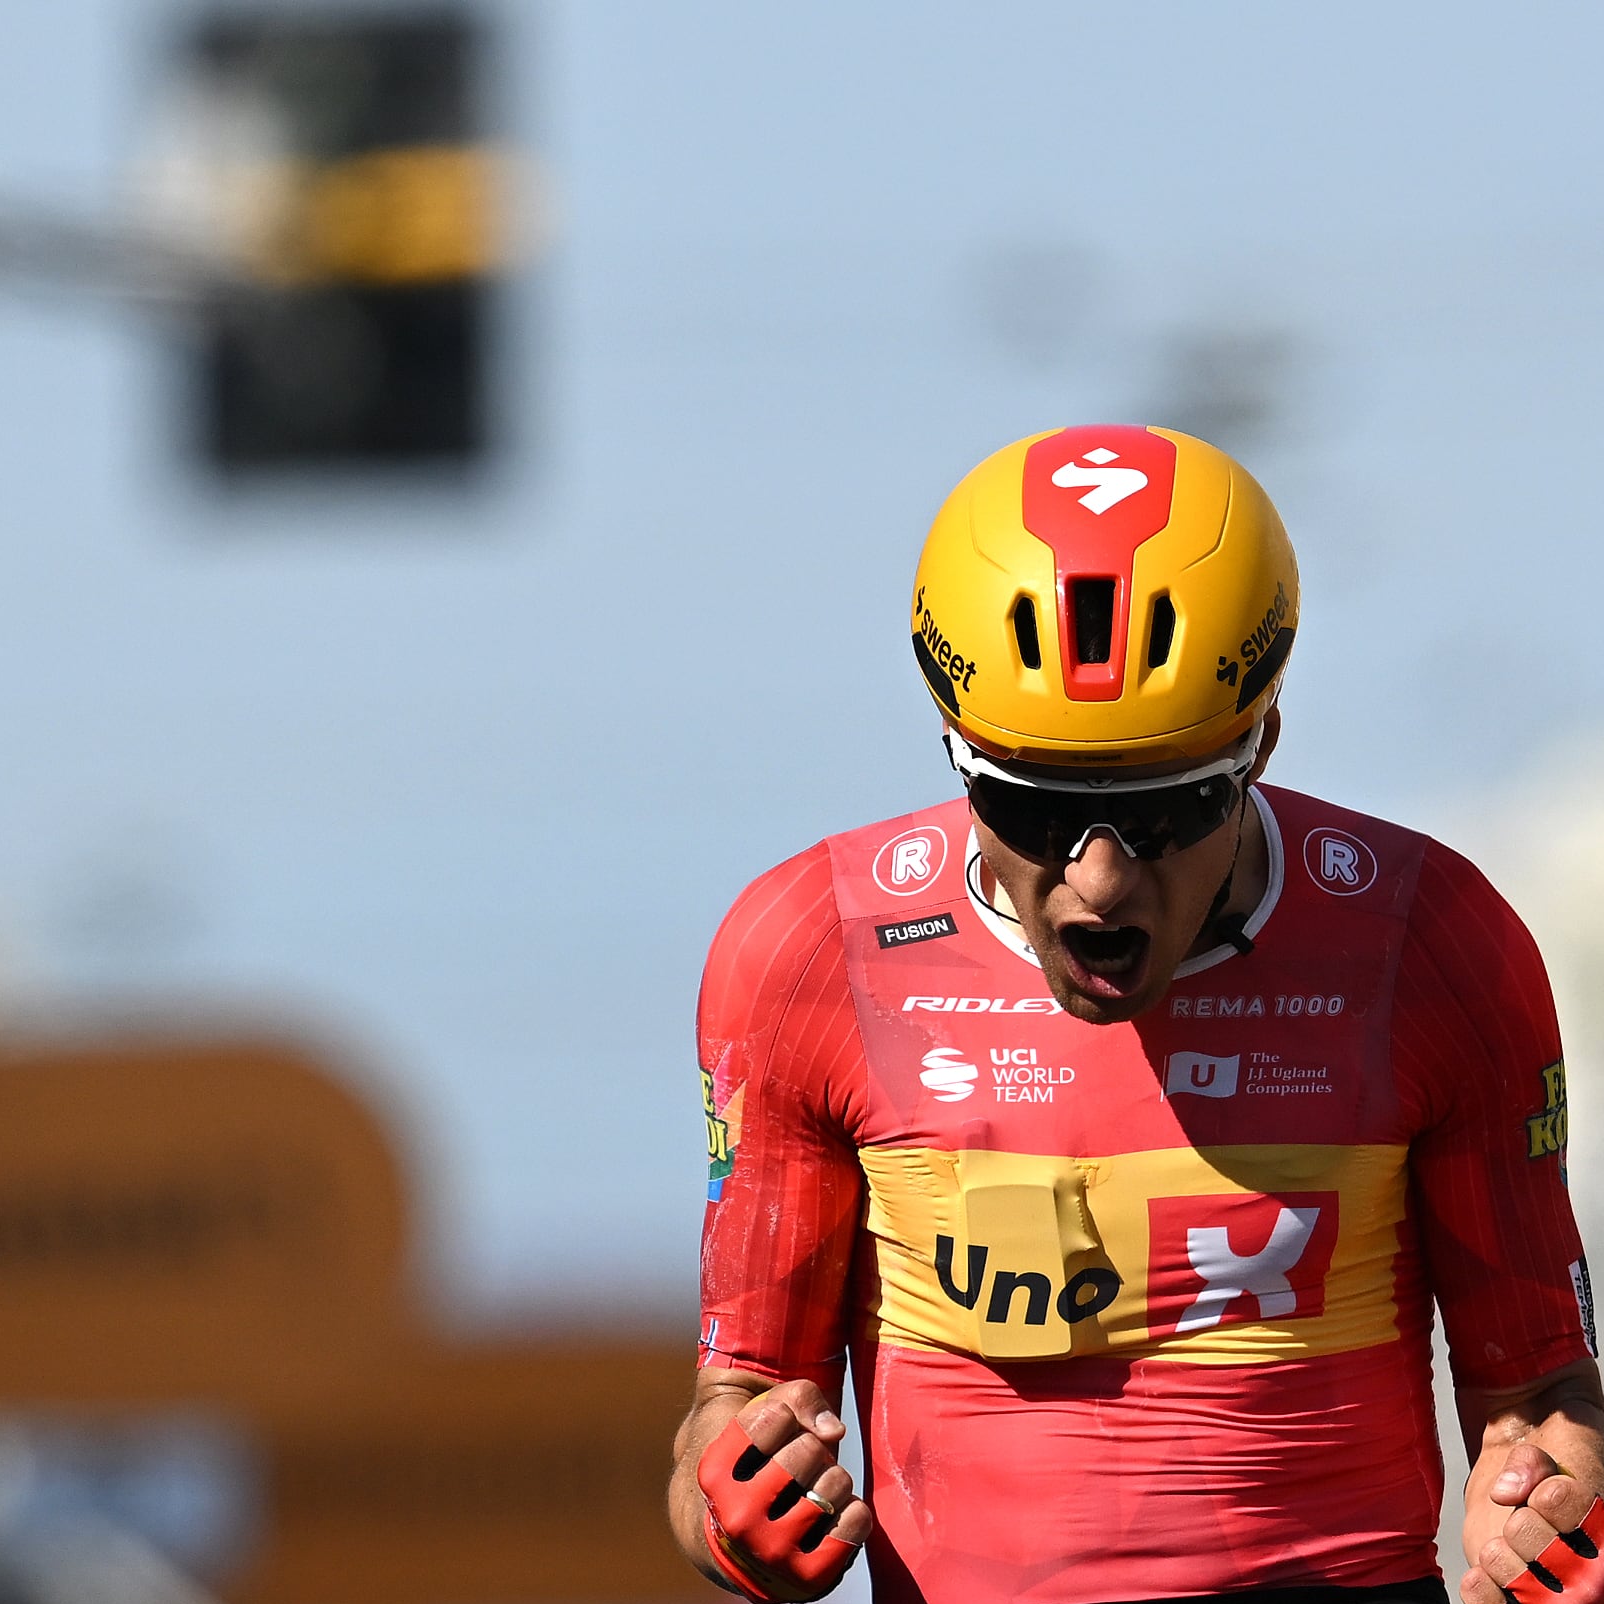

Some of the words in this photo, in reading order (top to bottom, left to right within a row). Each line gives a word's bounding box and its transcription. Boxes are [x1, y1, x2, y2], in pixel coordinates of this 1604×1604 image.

[1240, 581, 1289, 668] sweet
[921, 608, 977, 693] sweet
[885, 918, 949, 943] FUSION
[1171, 996, 1265, 1017] REMA
[1275, 995, 1345, 1016] 1000
[990, 1048, 1037, 1065] UCI
[1250, 1052, 1280, 1063] The
[992, 1067, 1076, 1084] WORLD
[1190, 1063, 1216, 1088] U
[1247, 1067, 1267, 1081] J.J.
[1272, 1067, 1328, 1081] Ugland
[993, 1086, 1054, 1103] TEAM
[1246, 1082, 1333, 1096] Companies
[934, 1233, 1122, 1325] Uno
[1175, 1206, 1321, 1333] X
